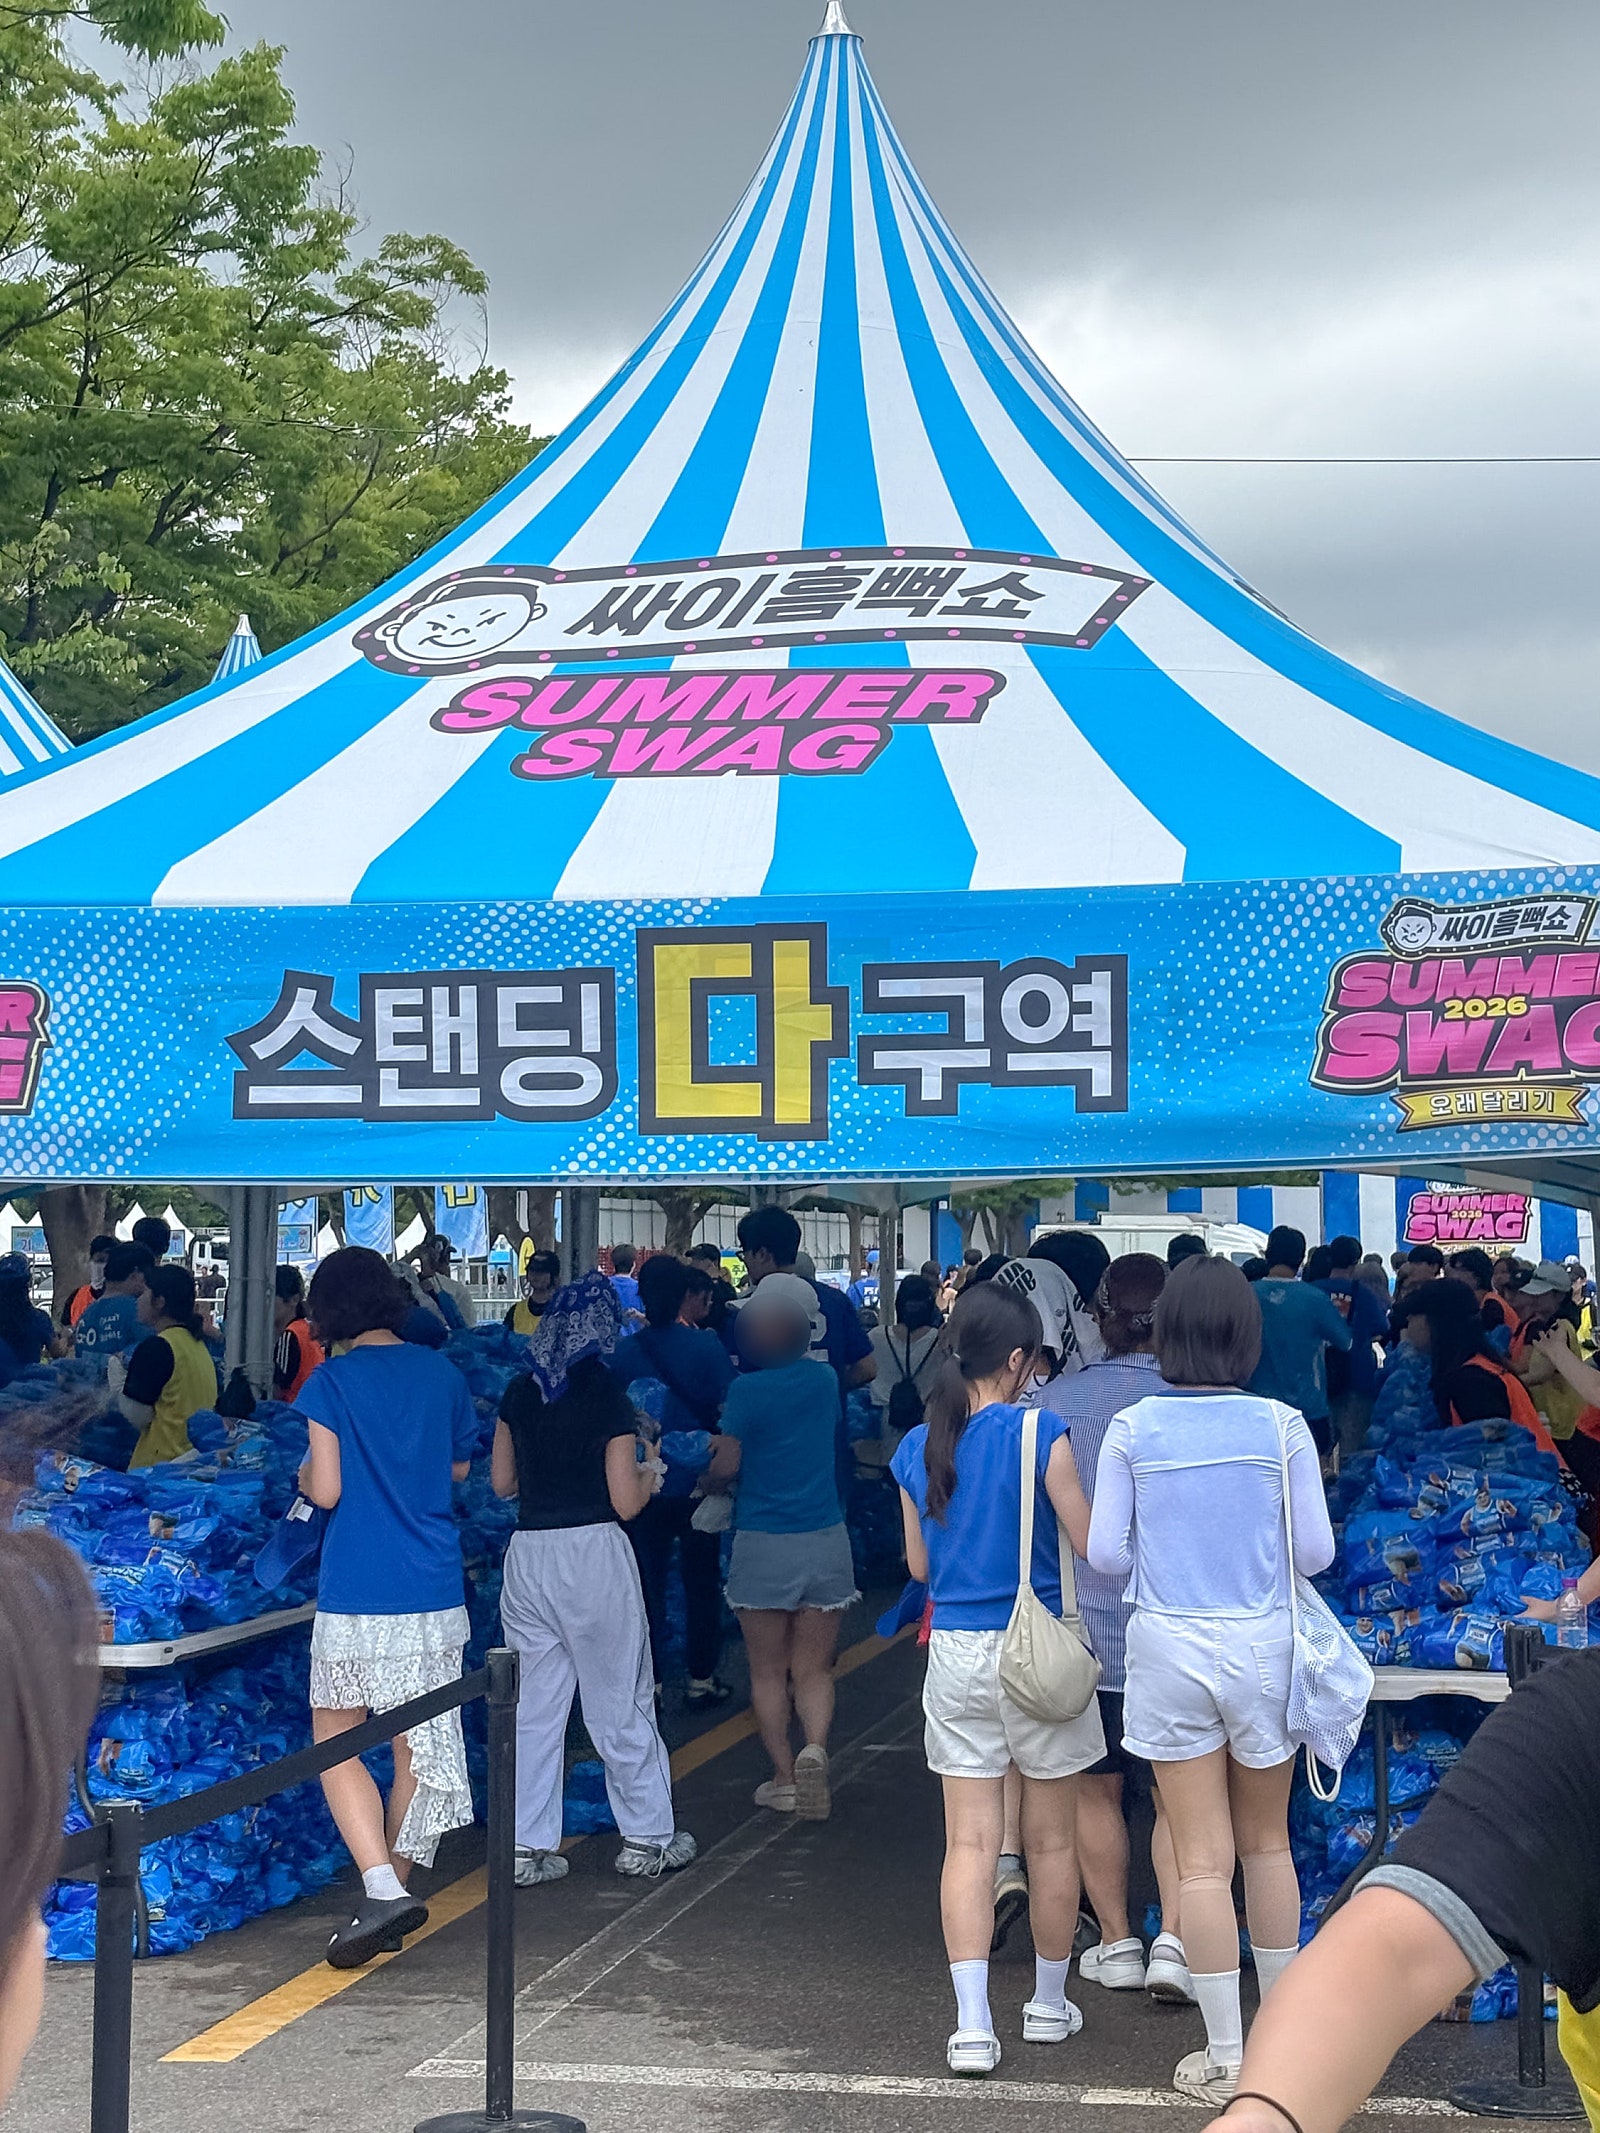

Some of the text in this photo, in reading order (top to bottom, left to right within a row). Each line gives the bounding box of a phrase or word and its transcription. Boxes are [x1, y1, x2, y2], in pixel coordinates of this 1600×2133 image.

[562, 565, 1047, 637] 싸이흠뻑쇼
[440, 673, 997, 729] SUMMER
[518, 724, 884, 776] SWAG
[1438, 904, 1572, 943] 싸이흠뻑쇼
[1337, 952, 1600, 1008] SUMME
[1443, 996, 1528, 1020] 2026
[248, 938, 1113, 1125] 스탠딩 다 구역
[1428, 1089, 1555, 1117] 오래달리기
[1407, 1211, 1524, 1240] SWAG
[1411, 1193, 1526, 1214] SUMMER
